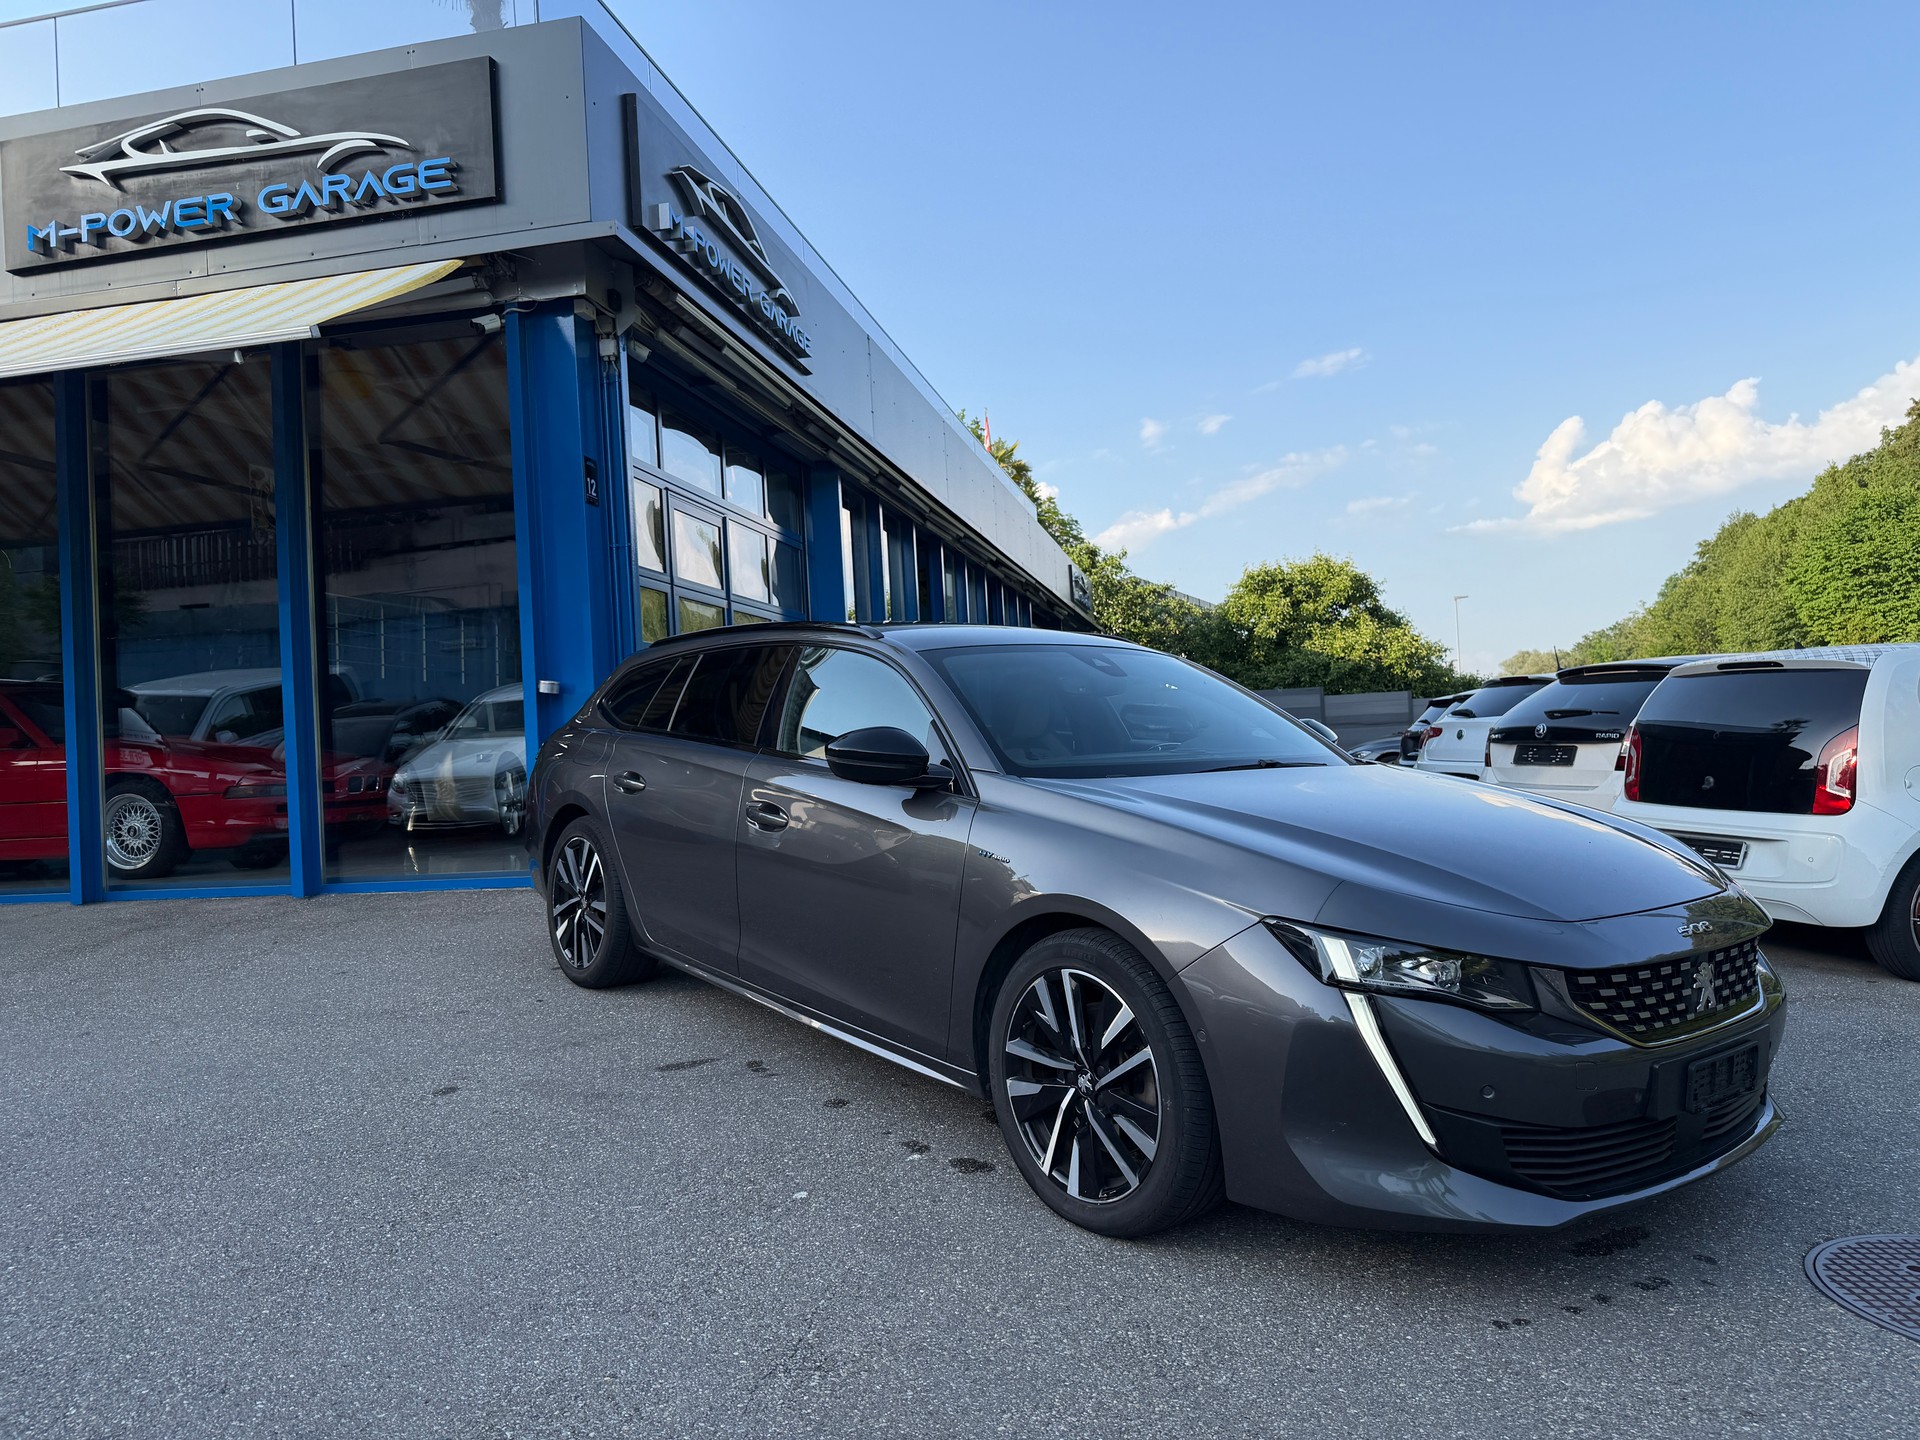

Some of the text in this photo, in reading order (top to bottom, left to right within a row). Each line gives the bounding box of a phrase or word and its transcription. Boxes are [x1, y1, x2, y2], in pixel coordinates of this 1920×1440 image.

[27, 157, 451, 251] M-POWER GARAGE
[669, 205, 813, 359] M-POWER GARAGE
[587, 477, 597, 497] 12
[1676, 920, 1713, 937] 508
